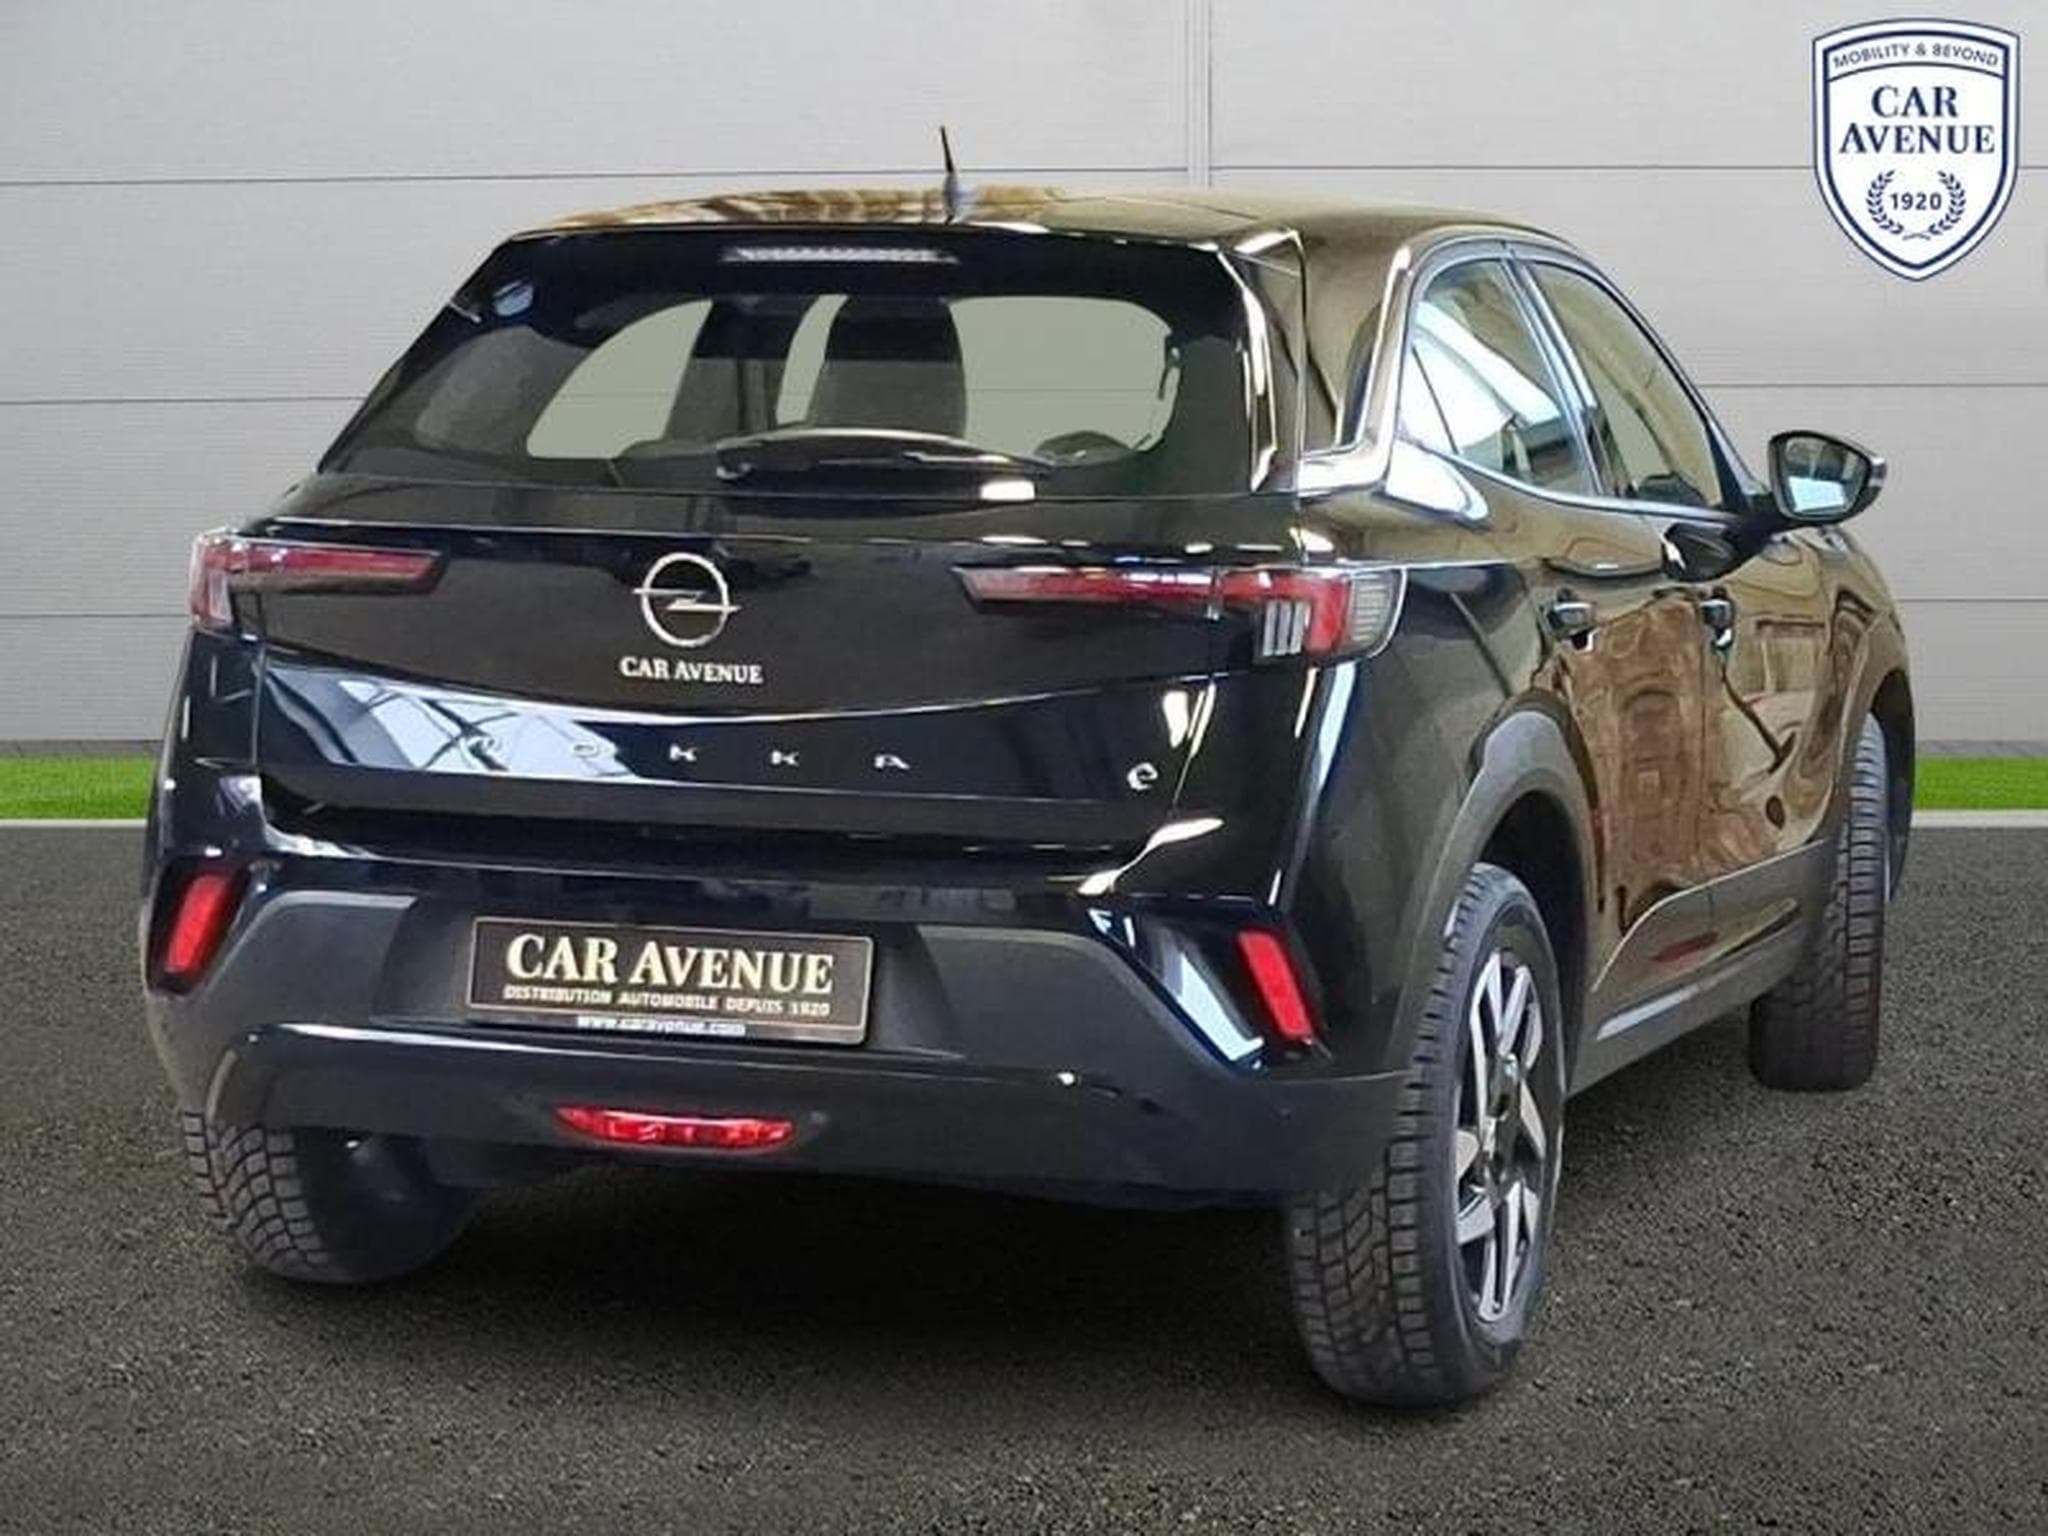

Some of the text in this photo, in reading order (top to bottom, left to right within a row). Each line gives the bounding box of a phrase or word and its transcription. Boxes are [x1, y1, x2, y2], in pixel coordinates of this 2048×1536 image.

[619, 656, 764, 685] CAR AVENUE
[505, 932, 834, 994] CAR AVENUE
[503, 983, 612, 1004] DISTRIBUTION
[617, 990, 718, 1010] AUTOMOBILE
[725, 997, 783, 1014] DEPUIS
